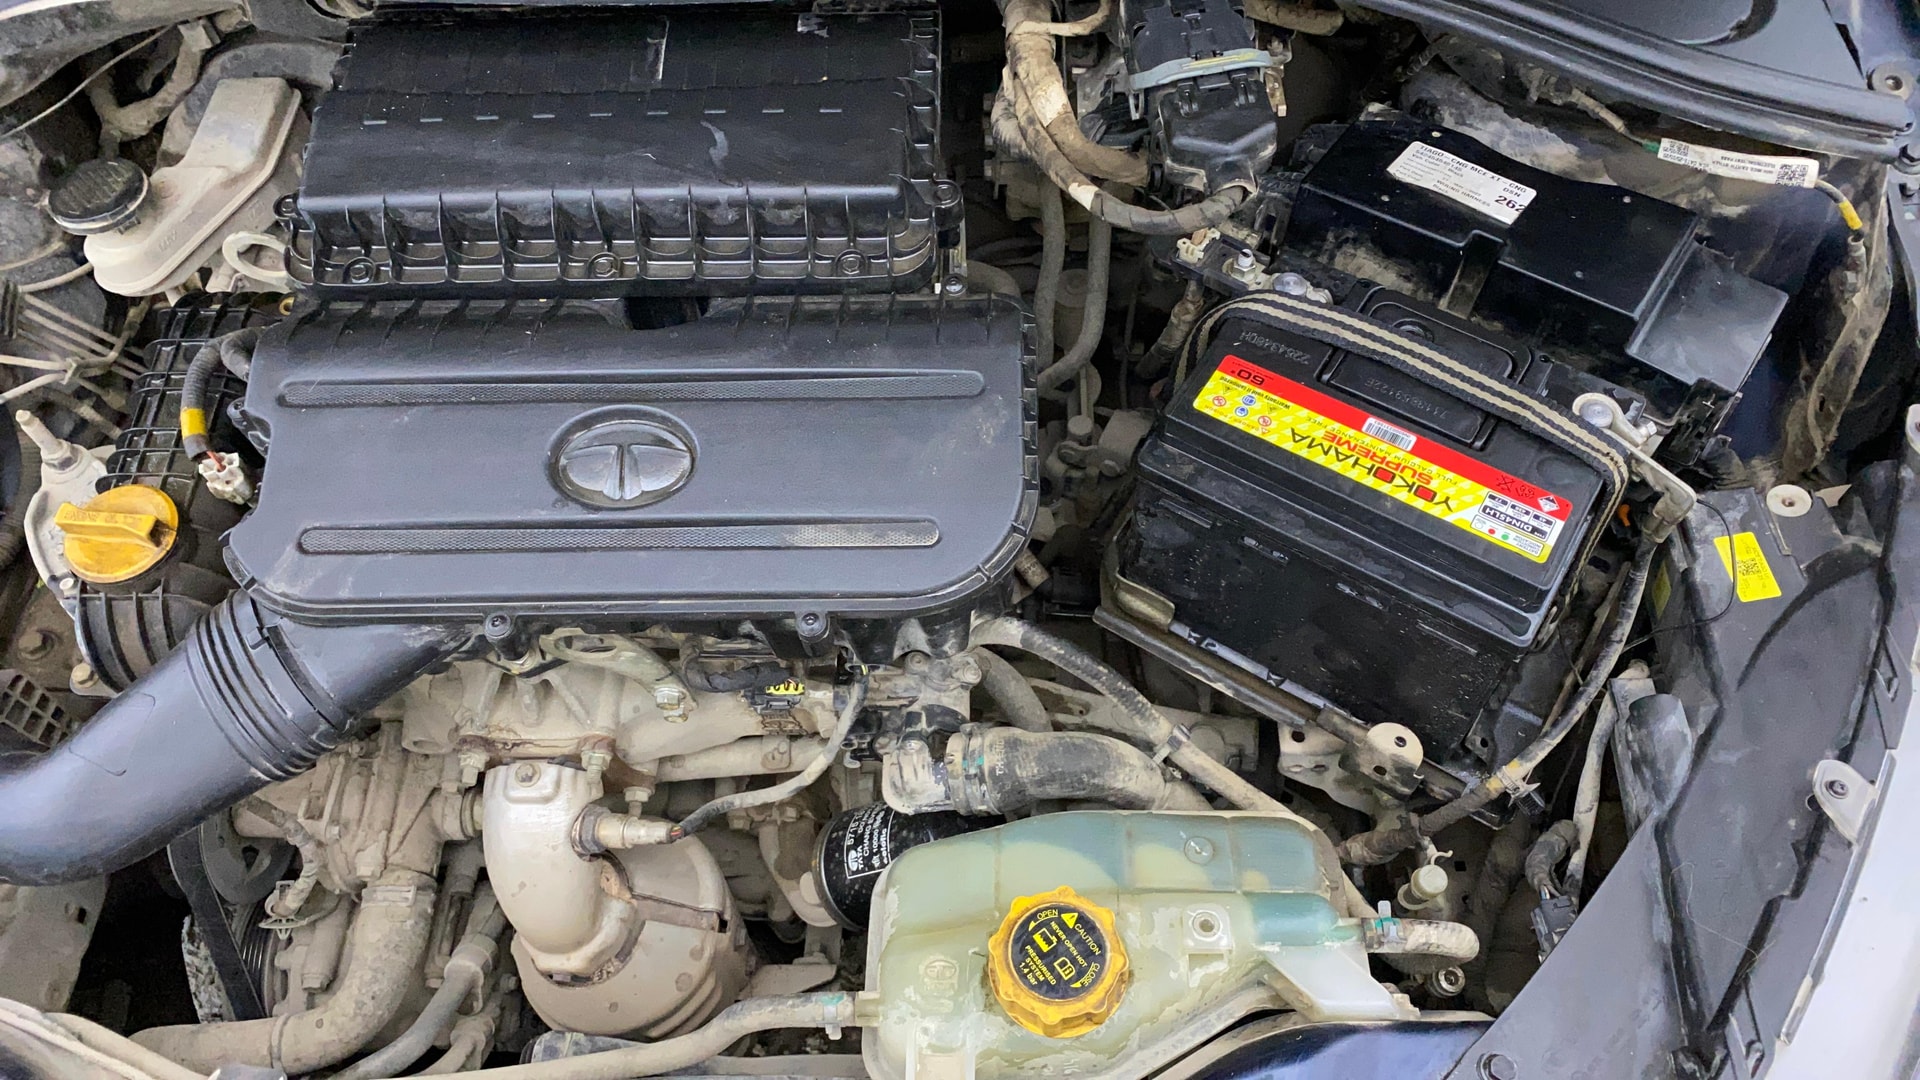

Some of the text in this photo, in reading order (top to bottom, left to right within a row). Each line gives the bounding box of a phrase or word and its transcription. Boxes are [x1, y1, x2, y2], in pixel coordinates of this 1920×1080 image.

[1420, 145, 1444, 157] TIAGO
[1451, 158, 1468, 168] CNG
[1509, 183, 1527, 193] CNG
[1305, 415, 1328, 428] FREE
[1329, 425, 1391, 456] MAINTENANCE
[1291, 427, 1451, 511] YOKOHAMA
[1320, 429, 1433, 485] SUPREME
[1393, 454, 1433, 474] CALCIUM
[1434, 472, 1457, 485] FULL
[1485, 507, 1532, 531] DIN45LH
[1037, 909, 1058, 920] OPEN
[1050, 921, 1087, 967] NEVER OPEN HOT
[1075, 924, 1101, 955] CAUTION
[1020, 962, 1038, 985] 1.4 bar
[1025, 945, 1056, 985] PRESSURISED
[1025, 957, 1045, 981] SYSTEM
[1081, 963, 1100, 987] CLOSE
